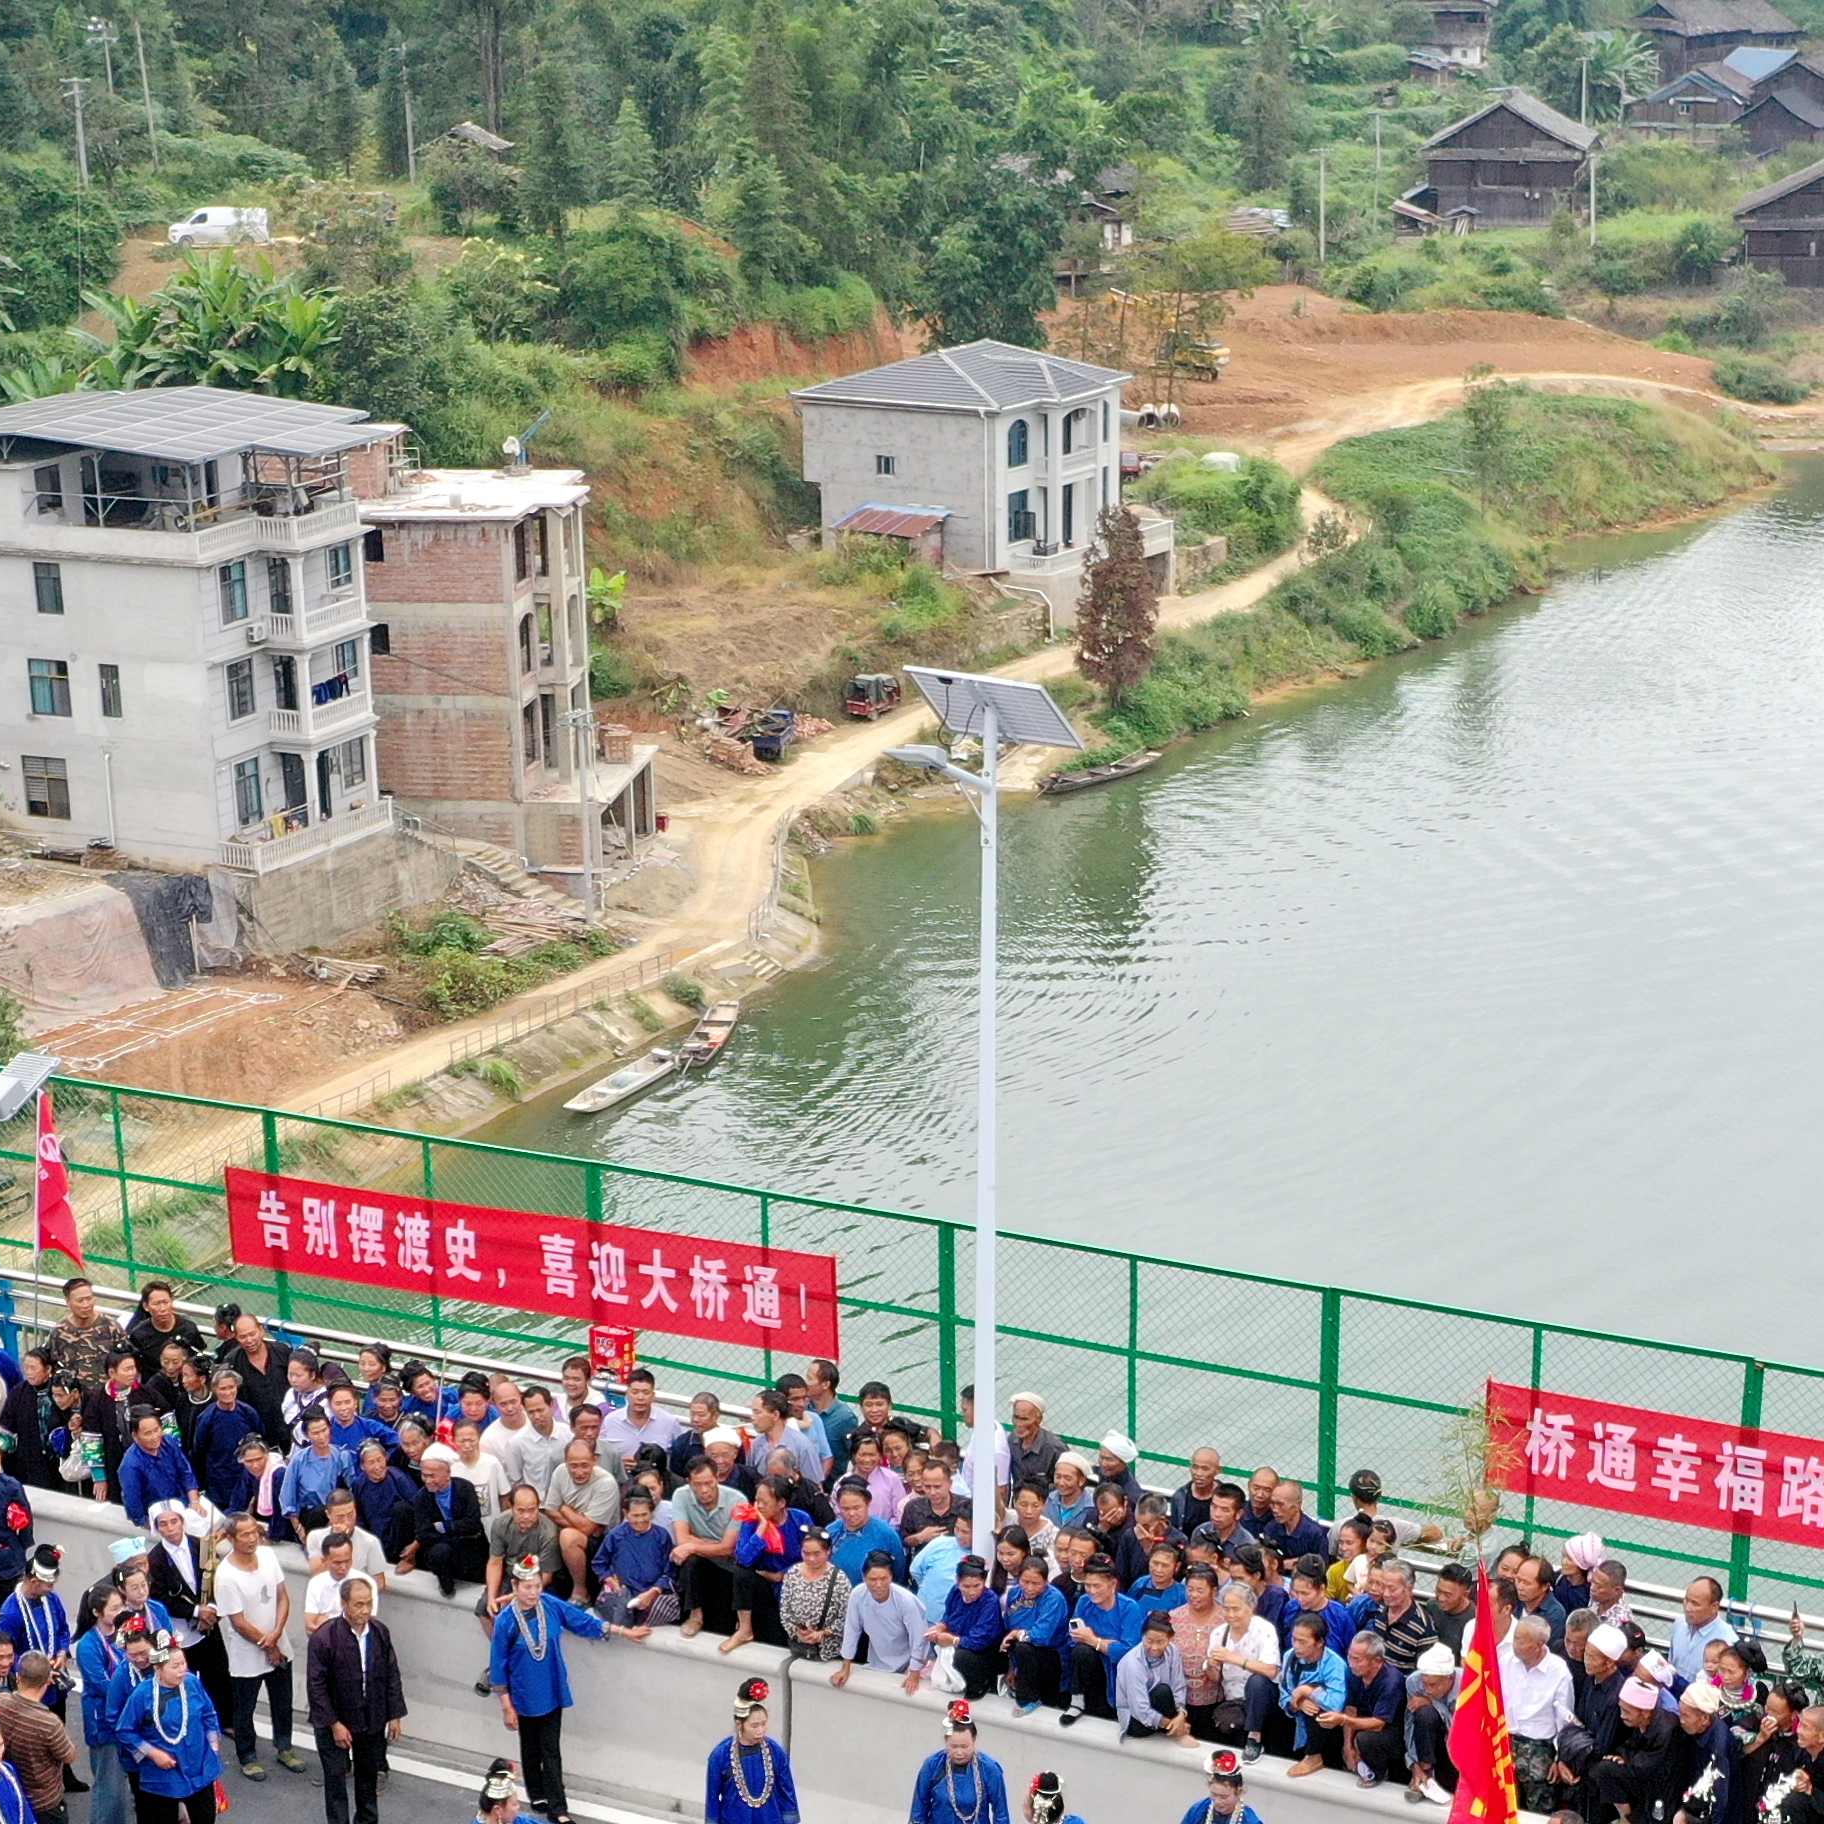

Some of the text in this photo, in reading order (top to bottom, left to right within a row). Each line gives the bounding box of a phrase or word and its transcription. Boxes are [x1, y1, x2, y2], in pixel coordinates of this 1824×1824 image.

[257, 1190, 808, 1332] 告别摆渡史，喜迎大桥通！
